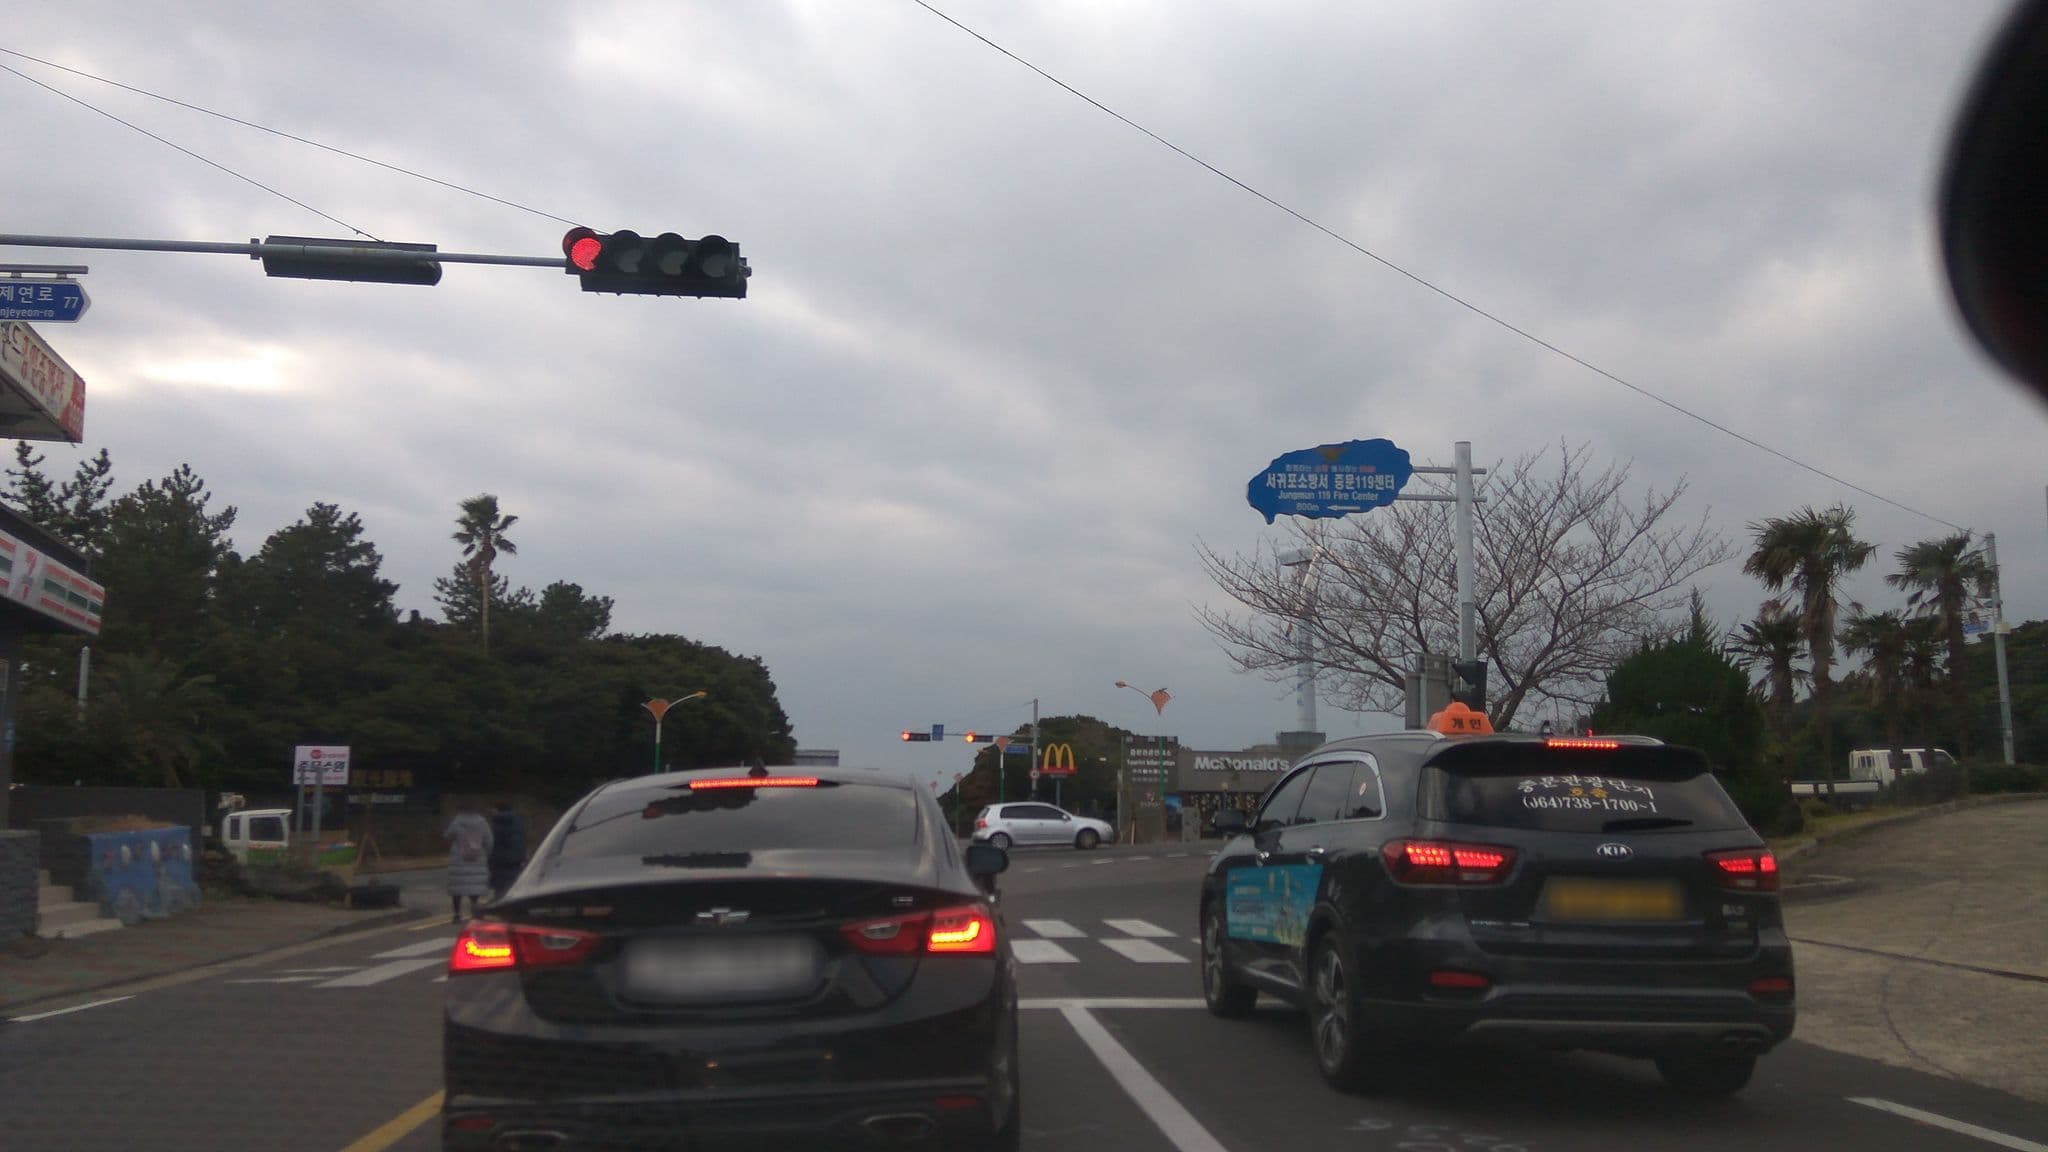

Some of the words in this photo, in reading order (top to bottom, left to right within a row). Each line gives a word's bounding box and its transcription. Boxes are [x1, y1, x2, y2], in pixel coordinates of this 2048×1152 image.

[63, 296, 80, 309] 77
[1266, 473, 1329, 489] 서귀포소방서
[1334, 474, 1396, 490] 중문119센터
[1318, 490, 1331, 500] 119
[1333, 491, 1349, 500] Fire
[1352, 490, 1379, 501] Center
[1146, 759, 1175, 767] Inforation
[1194, 757, 1290, 772] McDonald's
